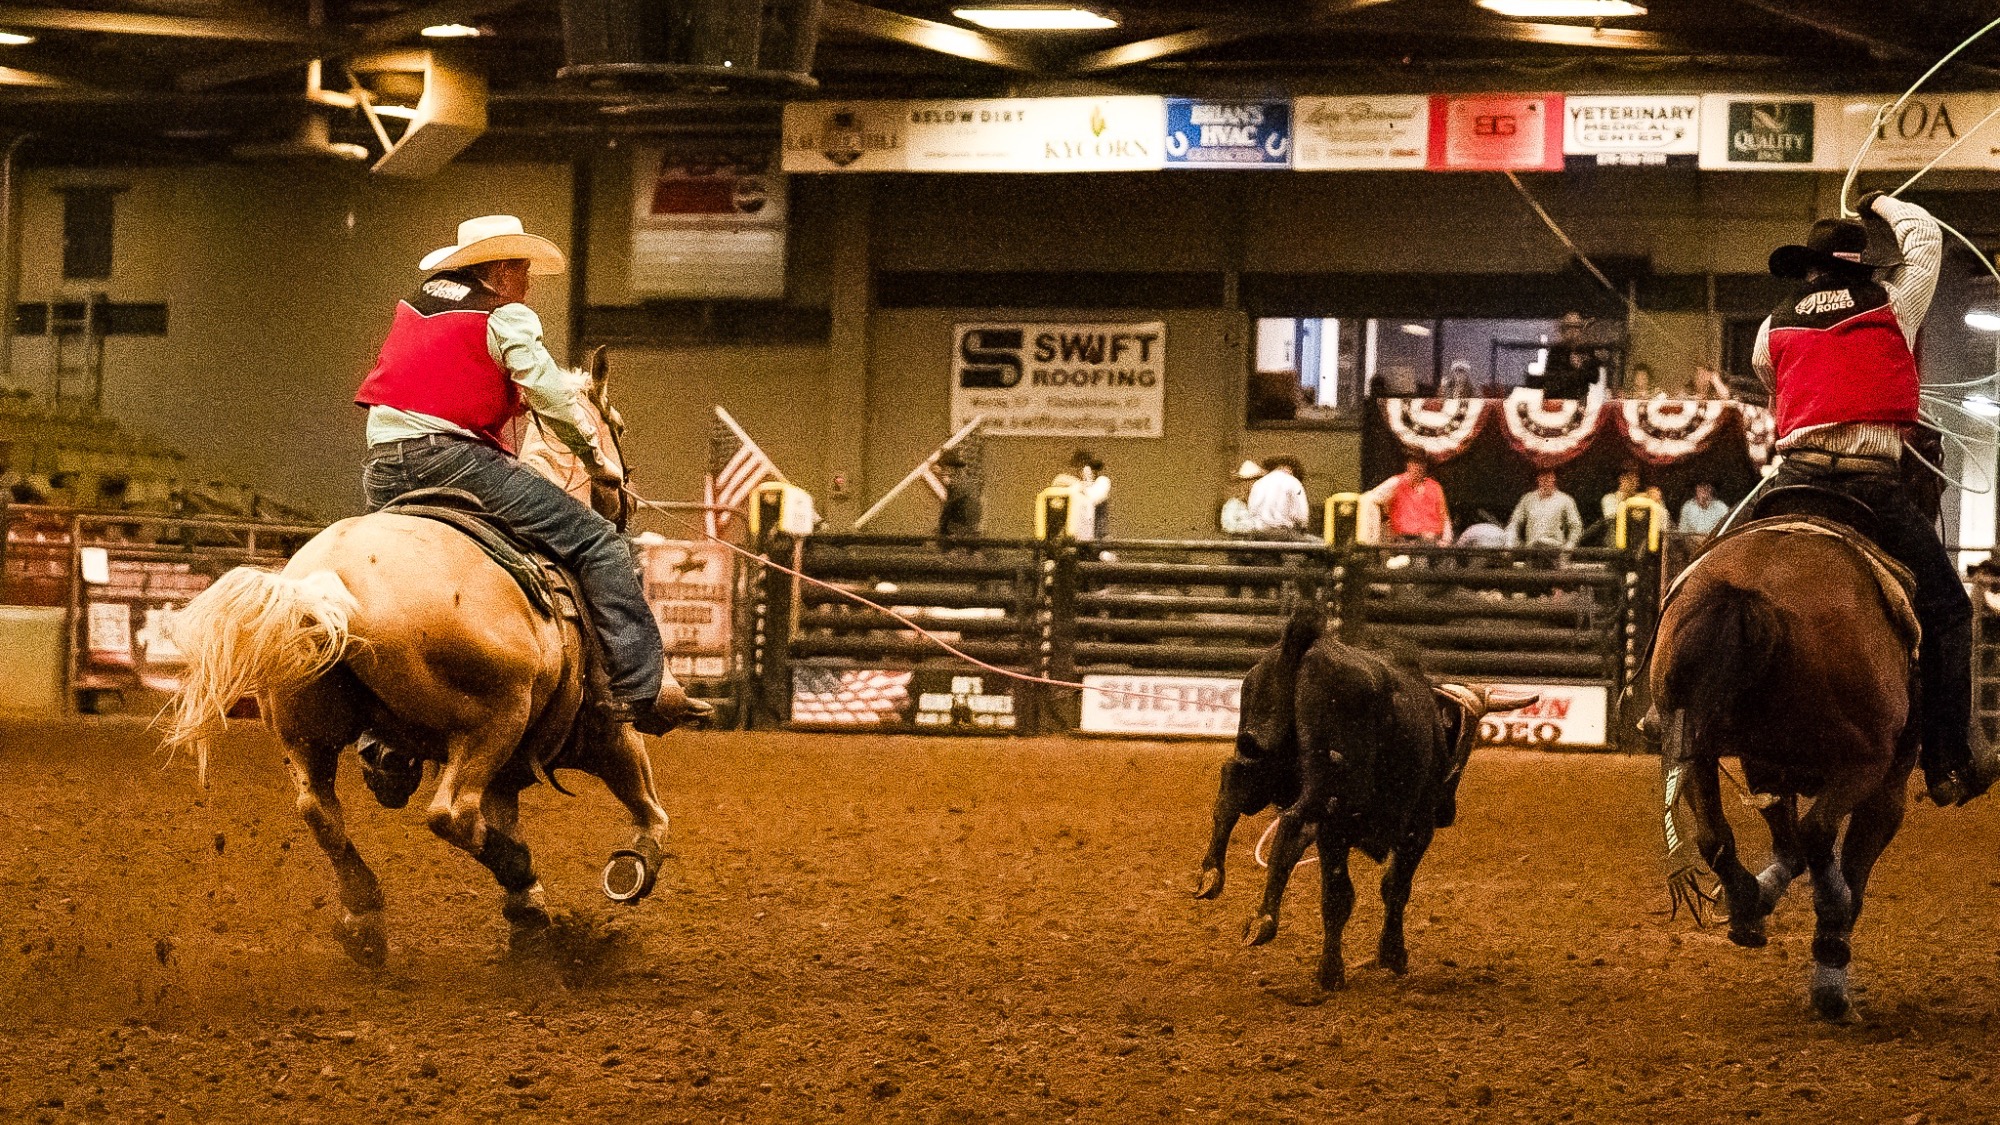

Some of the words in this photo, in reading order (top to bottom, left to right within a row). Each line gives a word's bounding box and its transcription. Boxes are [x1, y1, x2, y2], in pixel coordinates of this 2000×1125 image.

[911, 110, 973, 124] BELOW
[980, 109, 1026, 123] DIRT
[1569, 106, 1695, 121] VETERINARY
[1199, 125, 1258, 147] HVAC
[1043, 138, 1150, 159] KYCORN
[1815, 299, 1855, 314] RODEO
[1034, 332, 1159, 364] SWIFT
[1032, 368, 1157, 388] ROOFING
